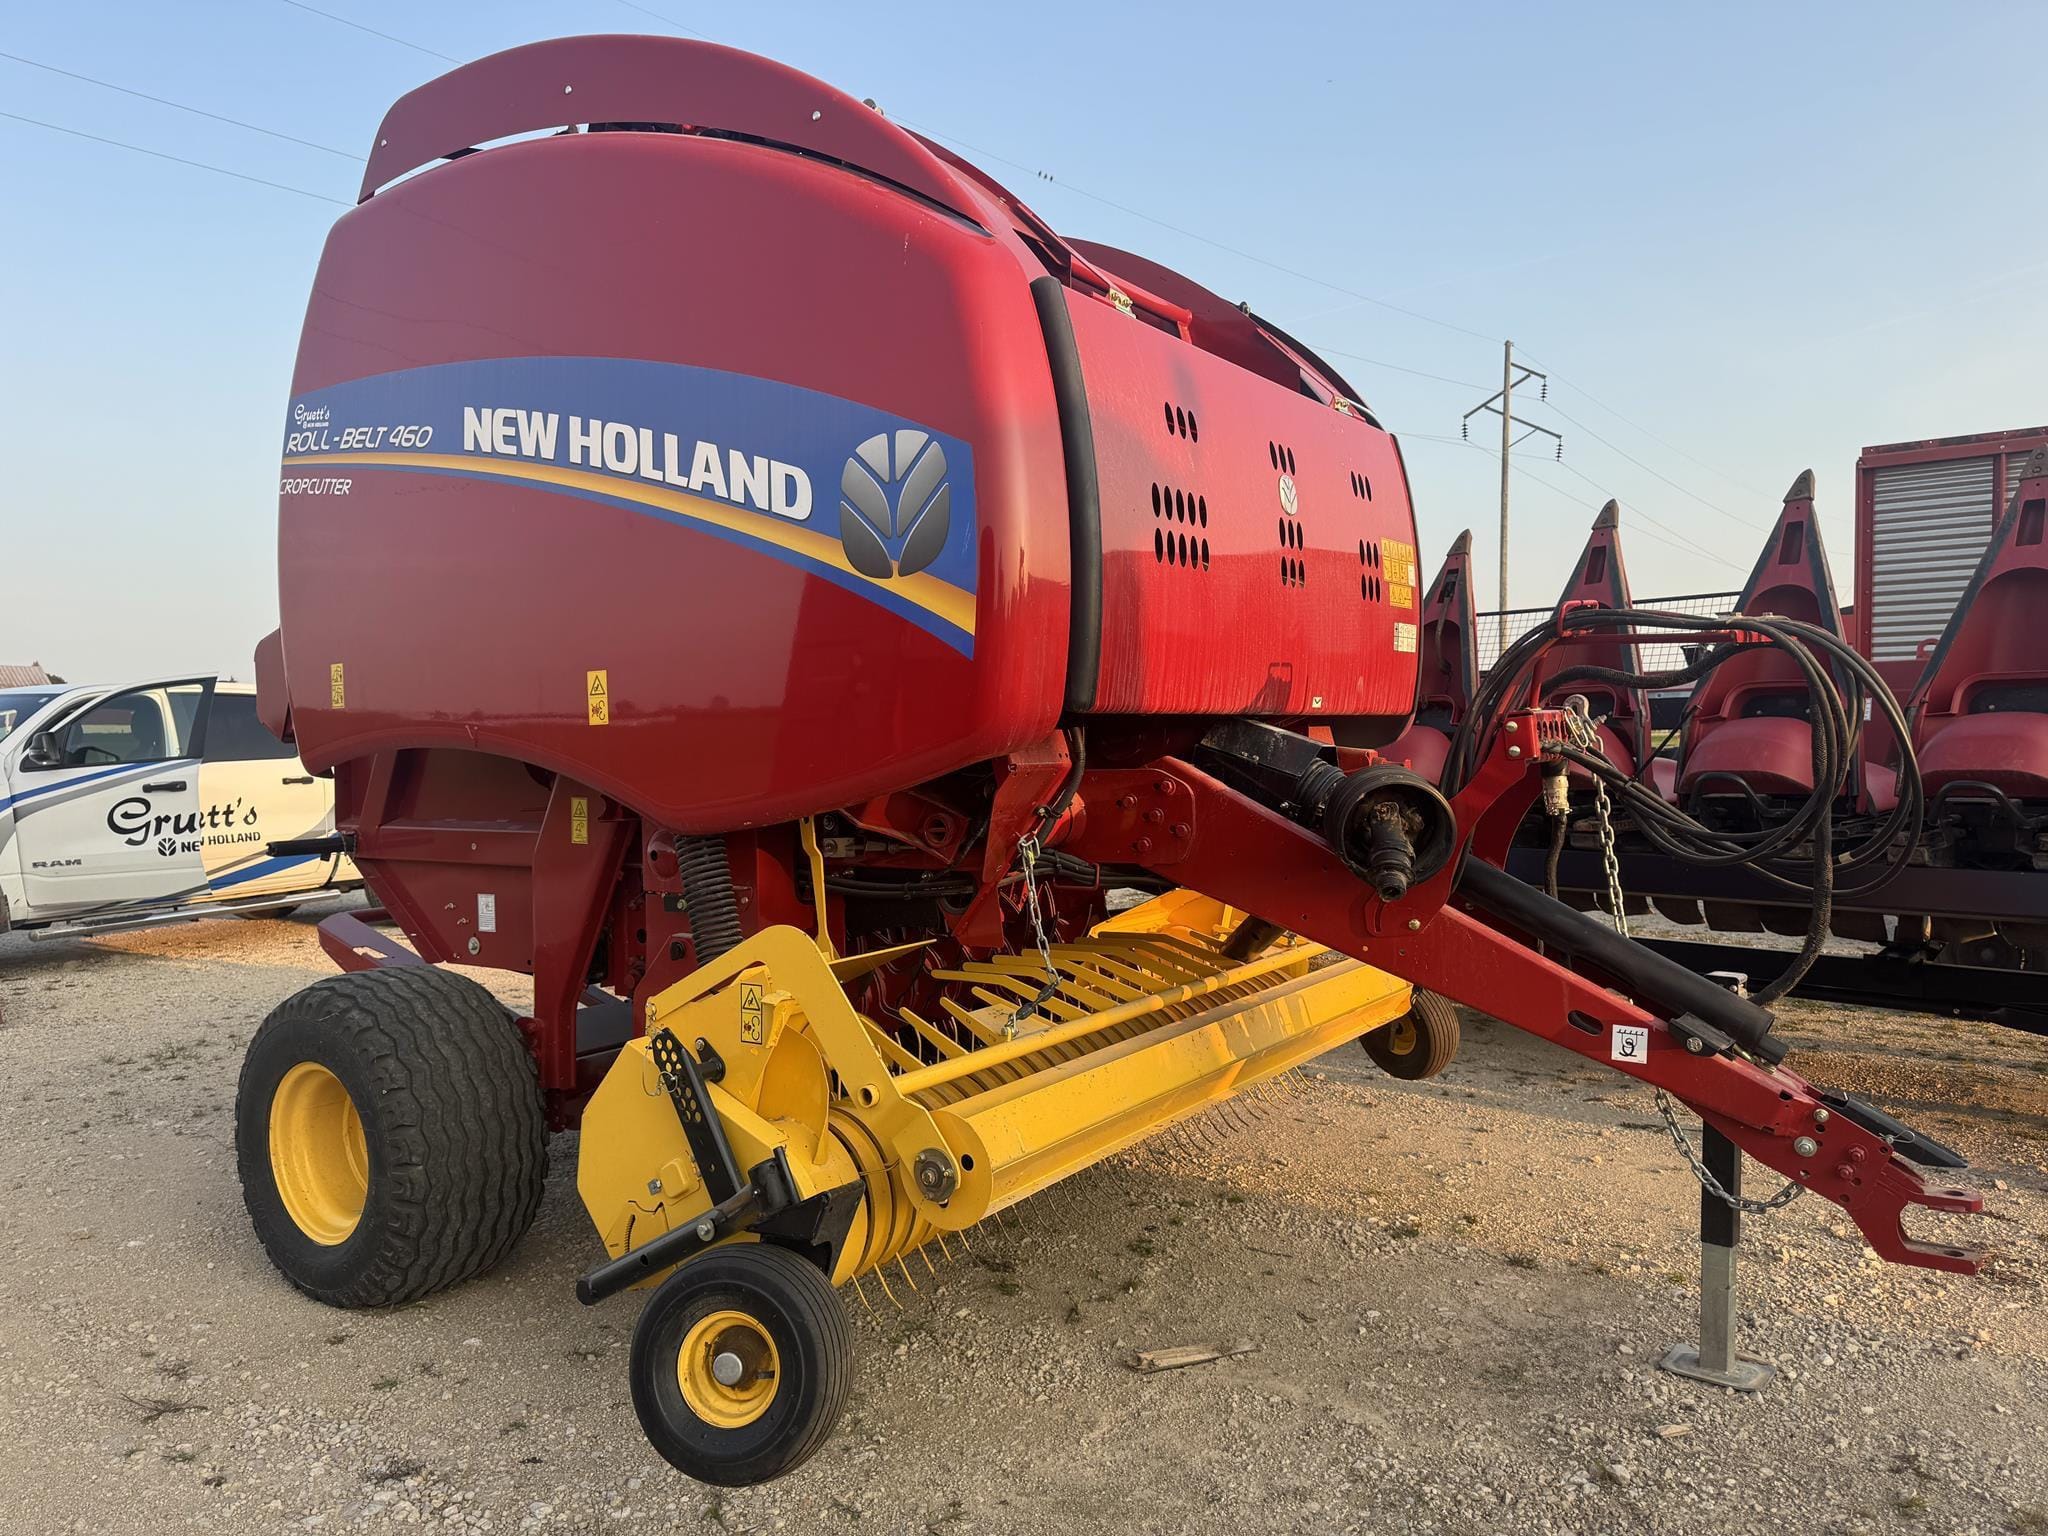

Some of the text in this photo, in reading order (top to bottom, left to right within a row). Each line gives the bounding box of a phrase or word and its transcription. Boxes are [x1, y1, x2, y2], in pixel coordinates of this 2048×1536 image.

[294, 403, 330, 425] Gruett's
[389, 425, 433, 448] 460
[463, 406, 813, 521] NEW HOLLAND
[279, 478, 353, 495] CROPCUTTER
[107, 797, 258, 847] Gruett's
[208, 831, 261, 846] HOLLAND
[32, 859, 82, 869] RAM
